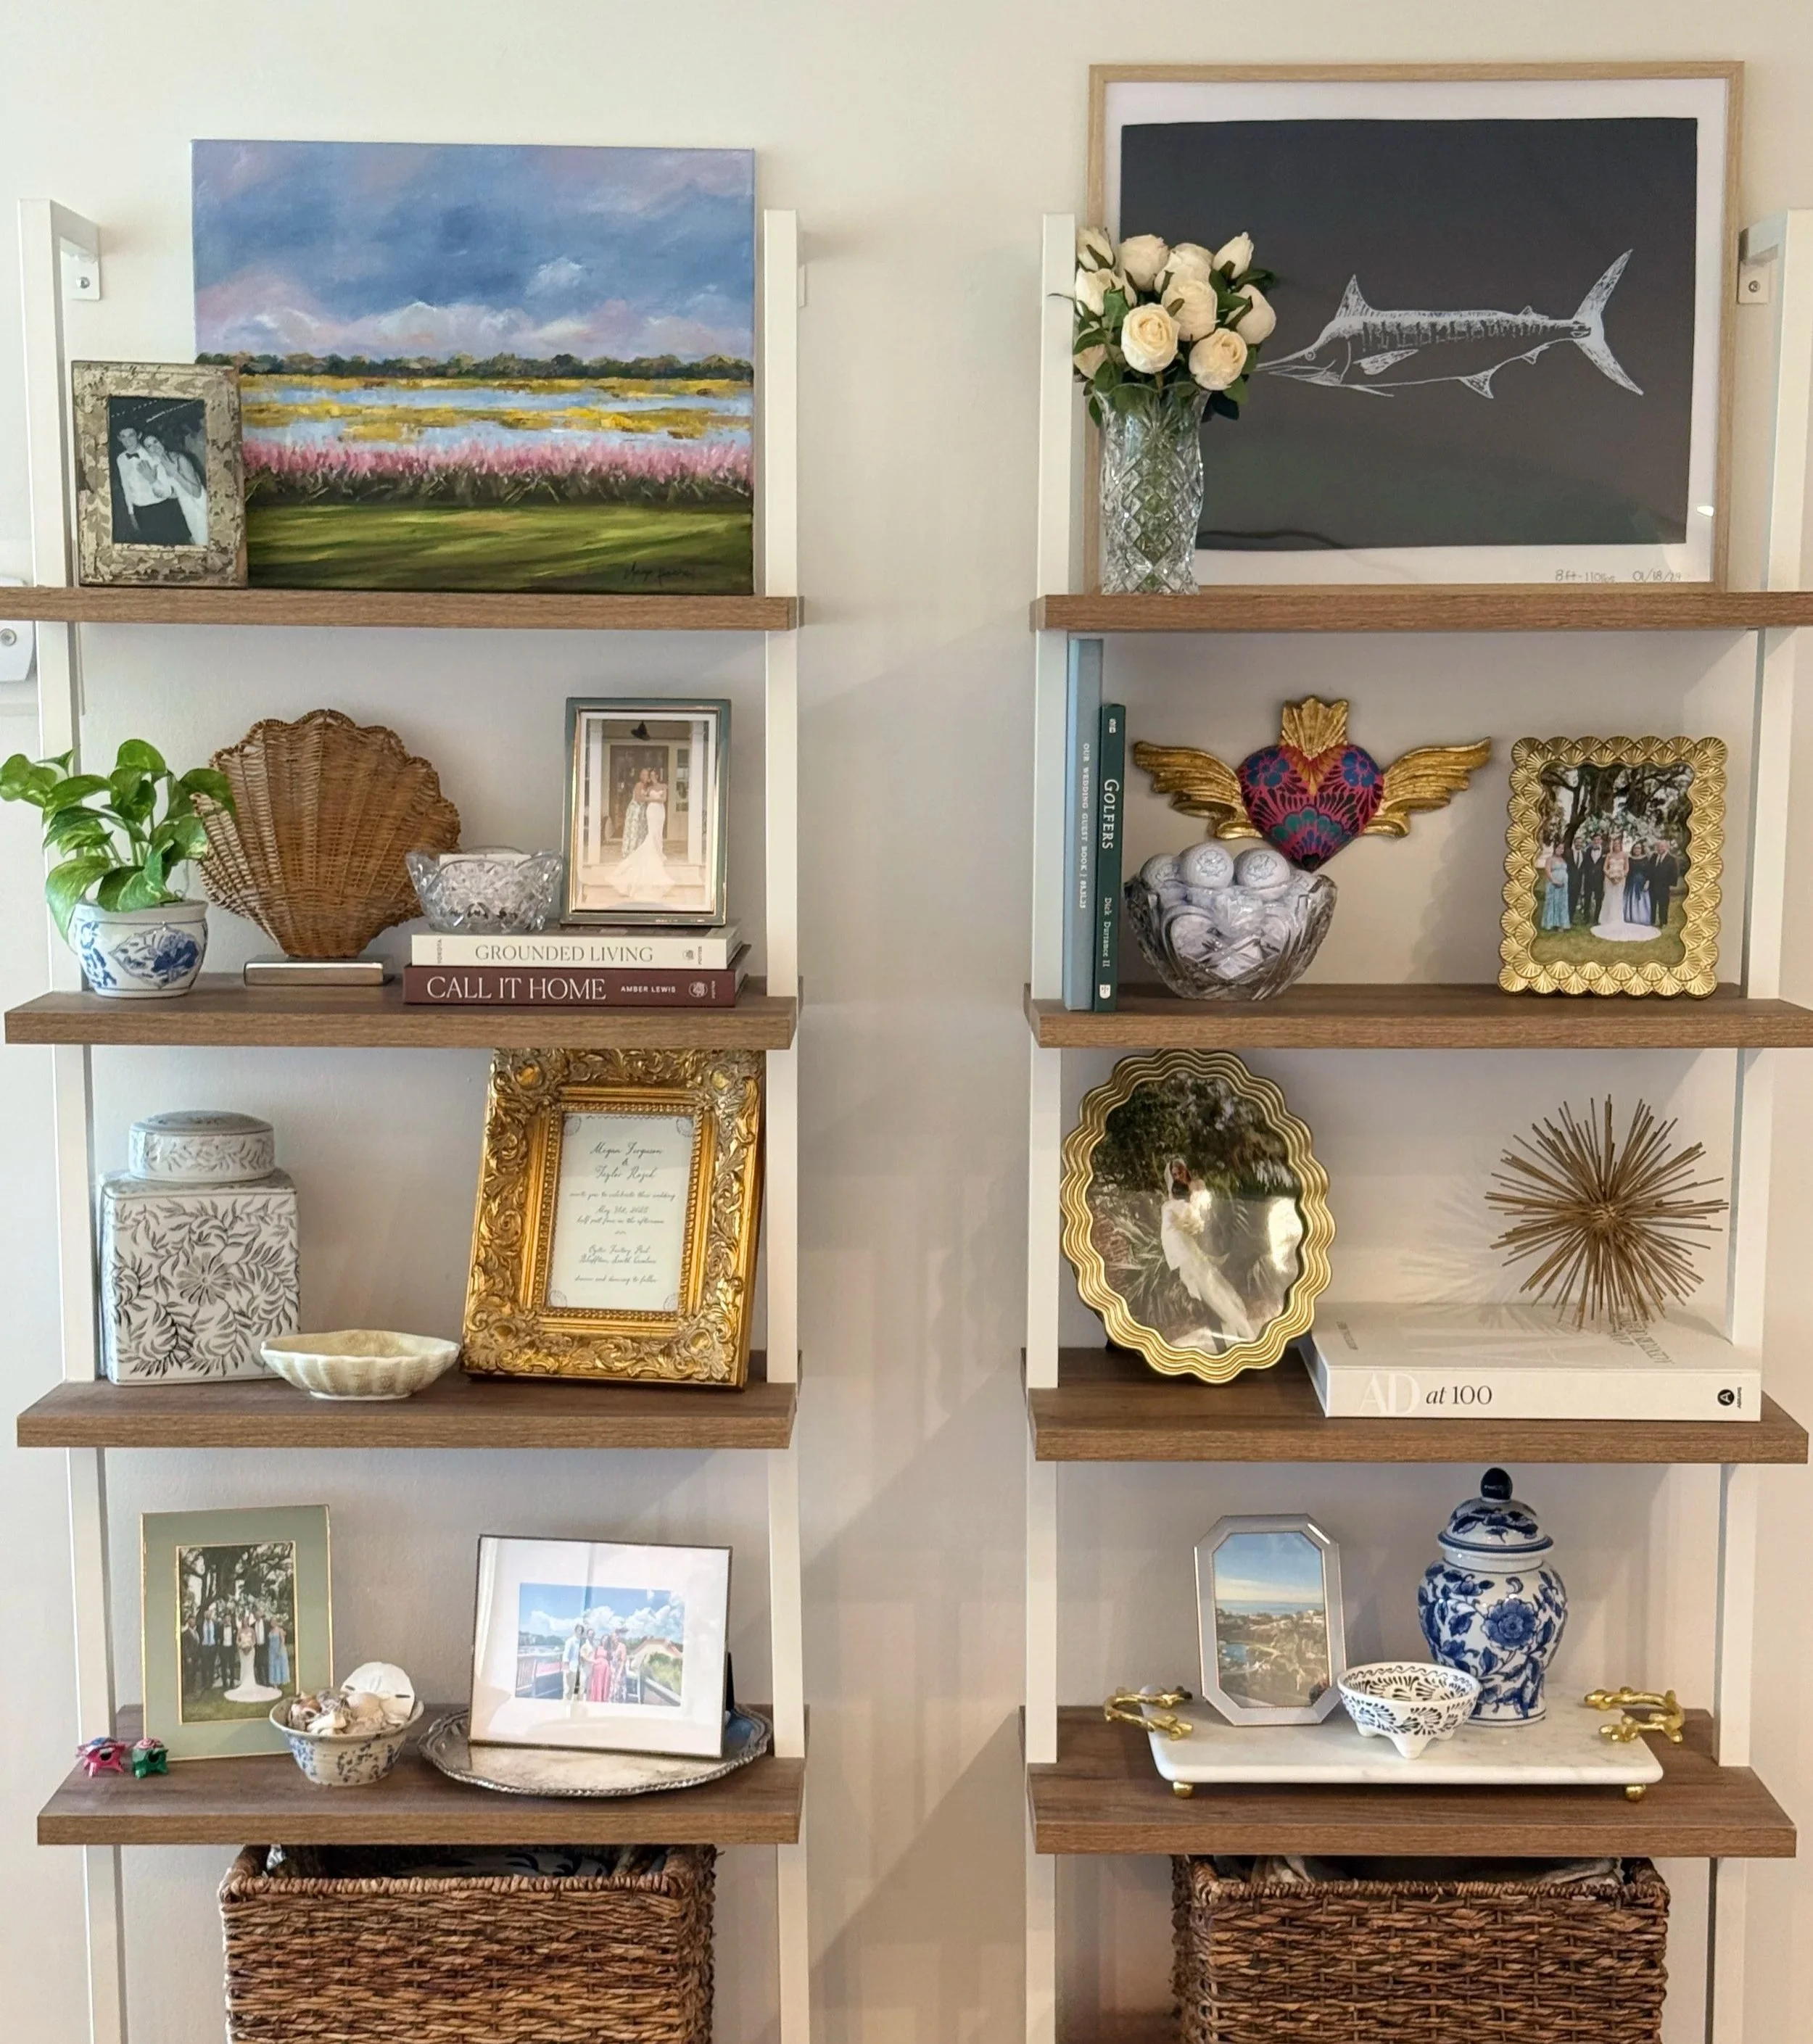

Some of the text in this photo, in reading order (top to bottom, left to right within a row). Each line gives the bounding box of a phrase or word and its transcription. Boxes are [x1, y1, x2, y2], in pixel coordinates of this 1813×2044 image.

[1102, 779, 1120, 849] GOLFERS
[1104, 897, 1112, 915] Dick
[475, 945, 653, 962] GROUNDED LIVING
[426, 976, 606, 1000] CALL IT HOME
[1359, 1373, 1492, 1415] AD at 100
